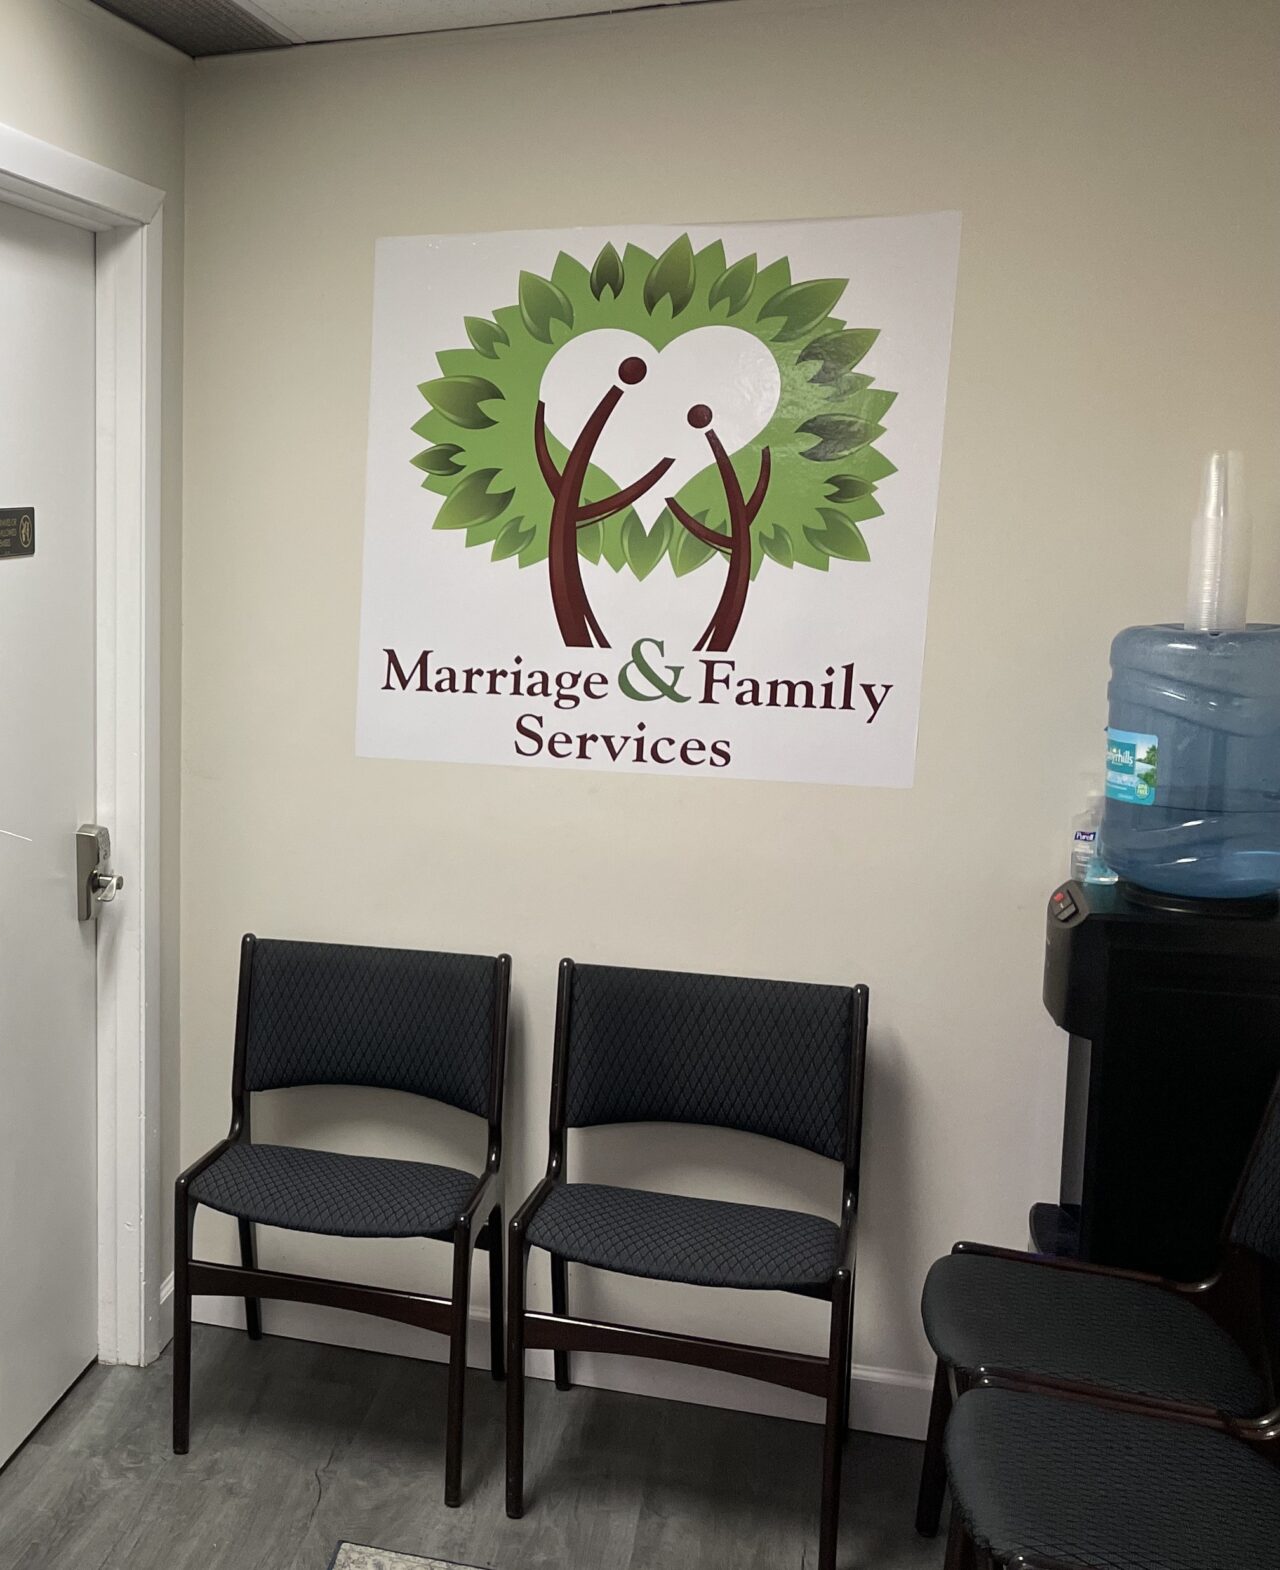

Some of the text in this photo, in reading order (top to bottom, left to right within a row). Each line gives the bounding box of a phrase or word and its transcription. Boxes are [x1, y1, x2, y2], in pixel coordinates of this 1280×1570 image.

[380, 637, 895, 724] Marriage & Family
[513, 712, 732, 768] Services
